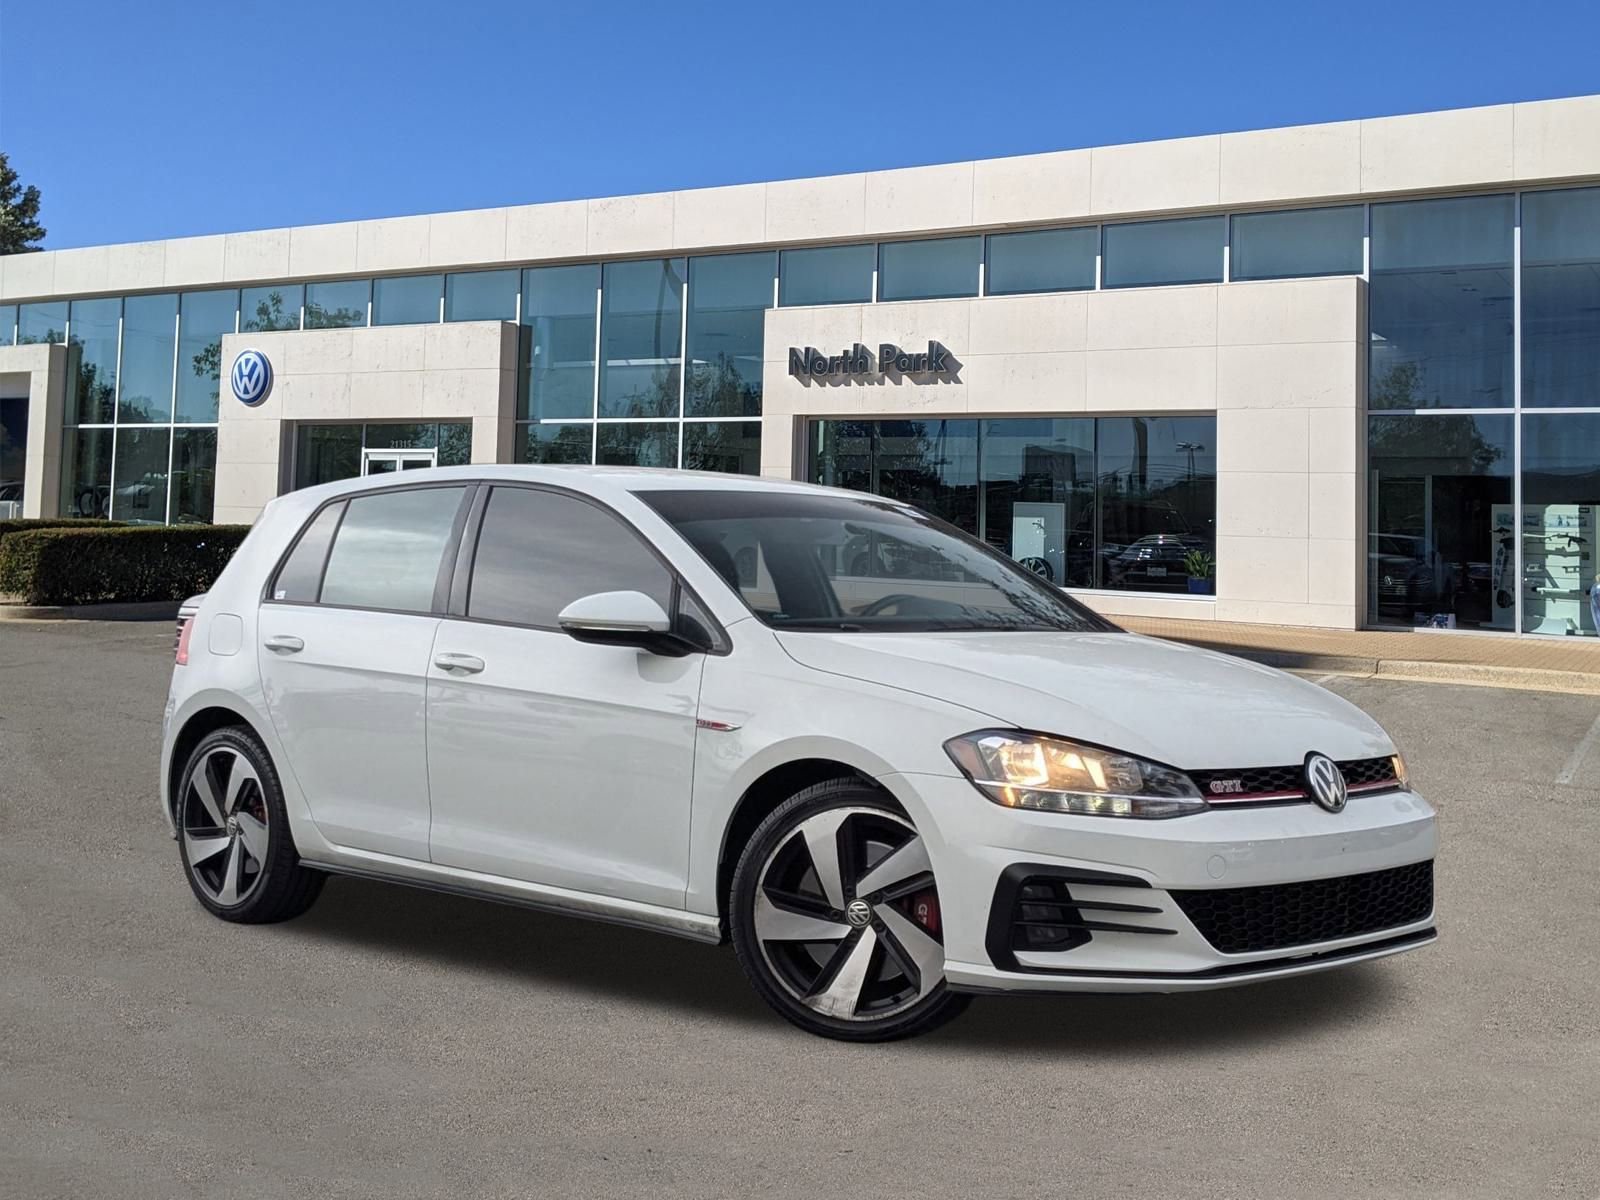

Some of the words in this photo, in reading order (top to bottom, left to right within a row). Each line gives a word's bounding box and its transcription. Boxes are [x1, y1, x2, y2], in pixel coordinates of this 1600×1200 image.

[232, 351, 269, 403] VW
[788, 343, 872, 376] North
[878, 340, 947, 373] Park
[1209, 779, 1244, 793] GTI
[1306, 752, 1348, 812] VW
